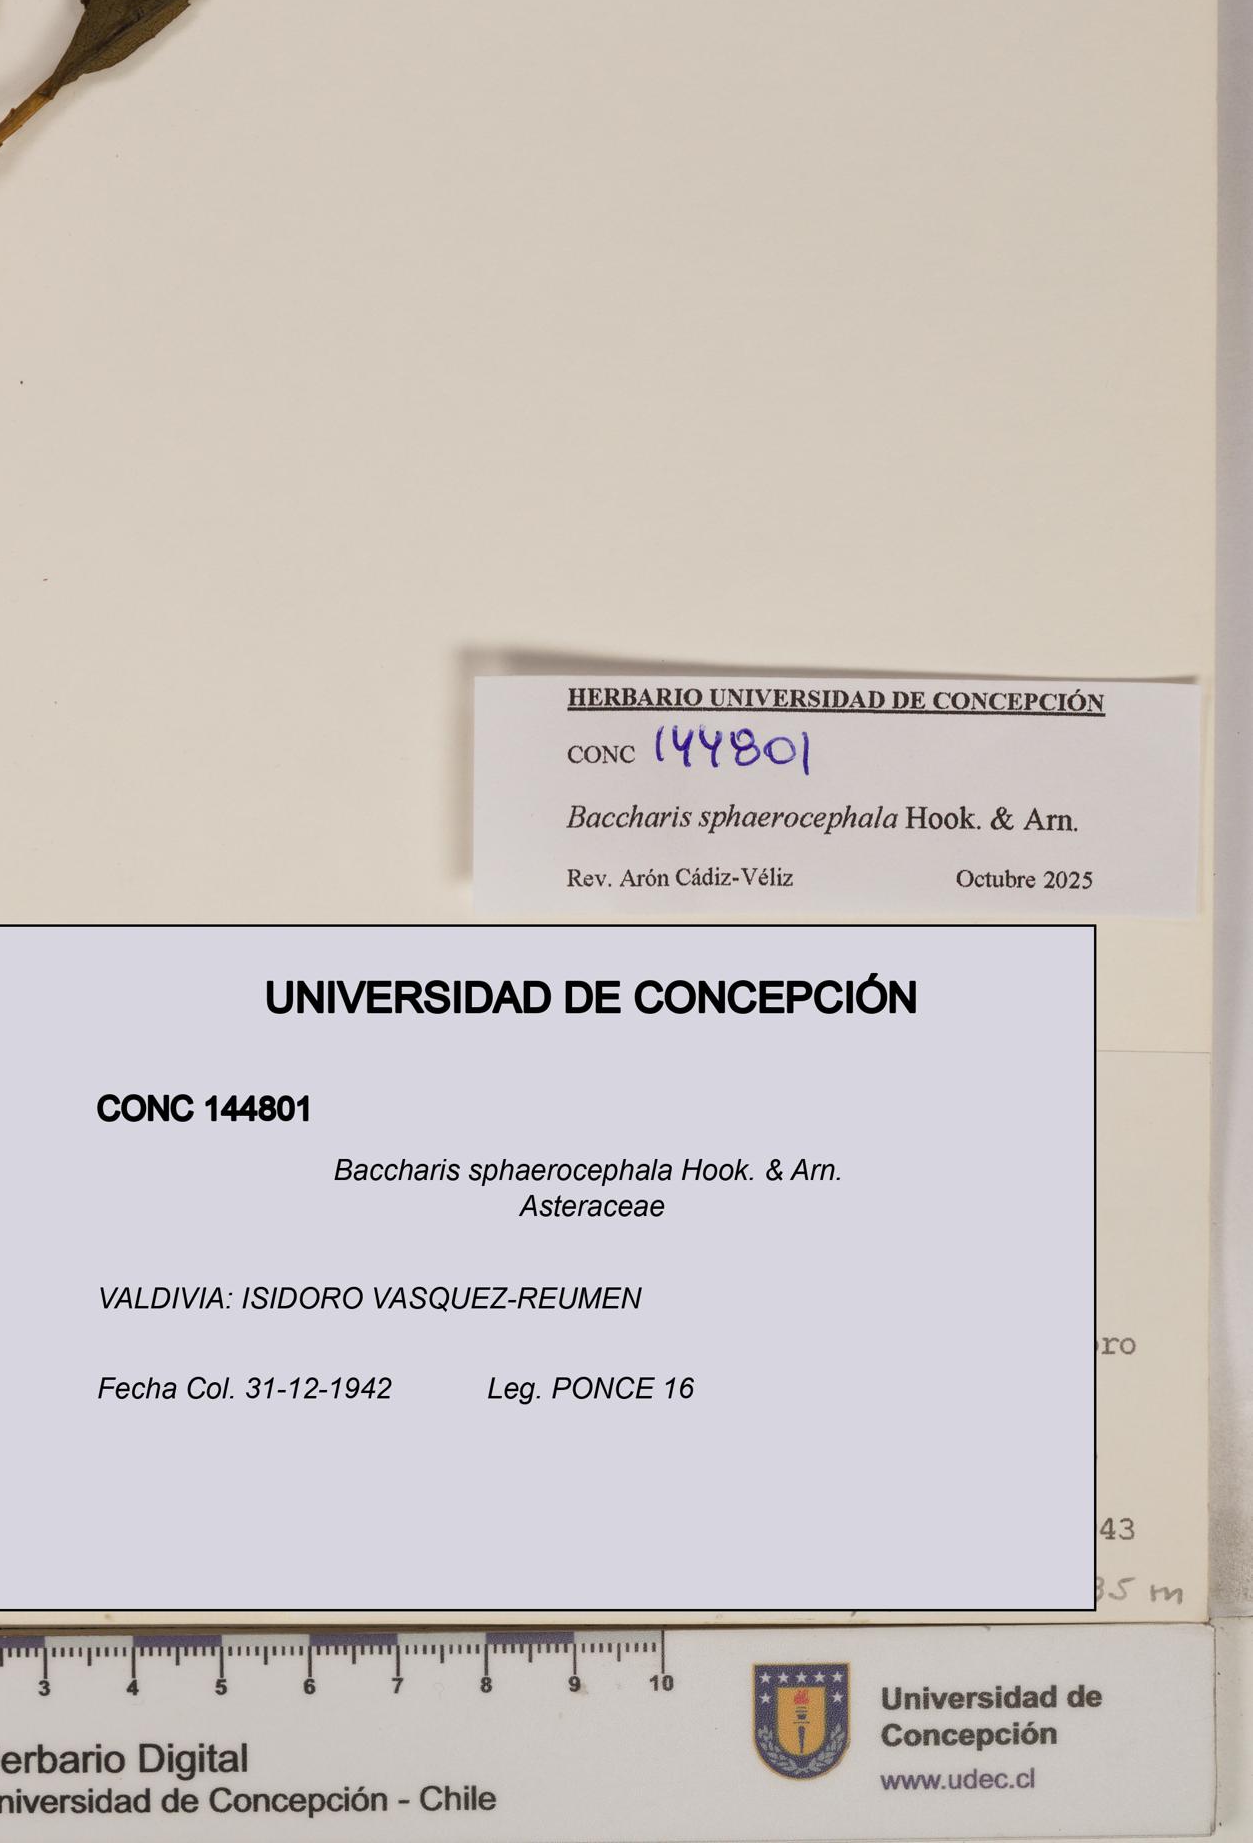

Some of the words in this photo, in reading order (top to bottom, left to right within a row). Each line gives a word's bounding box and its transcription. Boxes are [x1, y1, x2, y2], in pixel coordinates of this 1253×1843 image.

[567, 686, 703, 711] HERBARIO
[710, 687, 885, 712] UNIVERSIDAD
[892, 691, 927, 713] DE
[933, 688, 1106, 715] CONCEPCIÓN
[567, 745, 636, 764] CONC
[655, 725, 810, 774] 144801
[566, 804, 693, 829] Baccharis
[698, 803, 899, 835] sphaerocephala
[905, 805, 982, 830] Hook.
[990, 806, 1015, 831] &
[1023, 807, 1078, 832] Arn.
[566, 868, 612, 888] Rev.
[619, 868, 670, 888] Arón
[675, 866, 794, 887] Cádiz-Véliz
[956, 869, 1036, 889] Octubre
[1043, 870, 1093, 890] 2025
[1096, 1337, 1137, 1356] ro
[38, 1679, 51, 1697] 3
[126, 1678, 140, 1696] 4
[214, 1678, 228, 1696] 5
[303, 1678, 316, 1695] 6
[391, 1675, 404, 1694] 7
[480, 1676, 493, 1694] 8
[568, 1675, 582, 1693] 9
[649, 1674, 674, 1692] 10
[881, 1684, 1058, 1711] Universidad
[1066, 1684, 1103, 1708] de
[880, 1721, 1058, 1752] Concepción
[138, 1742, 248, 1782] Digital
[879, 1767, 1035, 1791] www.udec.cl
[161, 1787, 199, 1814] de
[208, 1786, 388, 1819] Concepción
[419, 1785, 497, 1812] Chile
